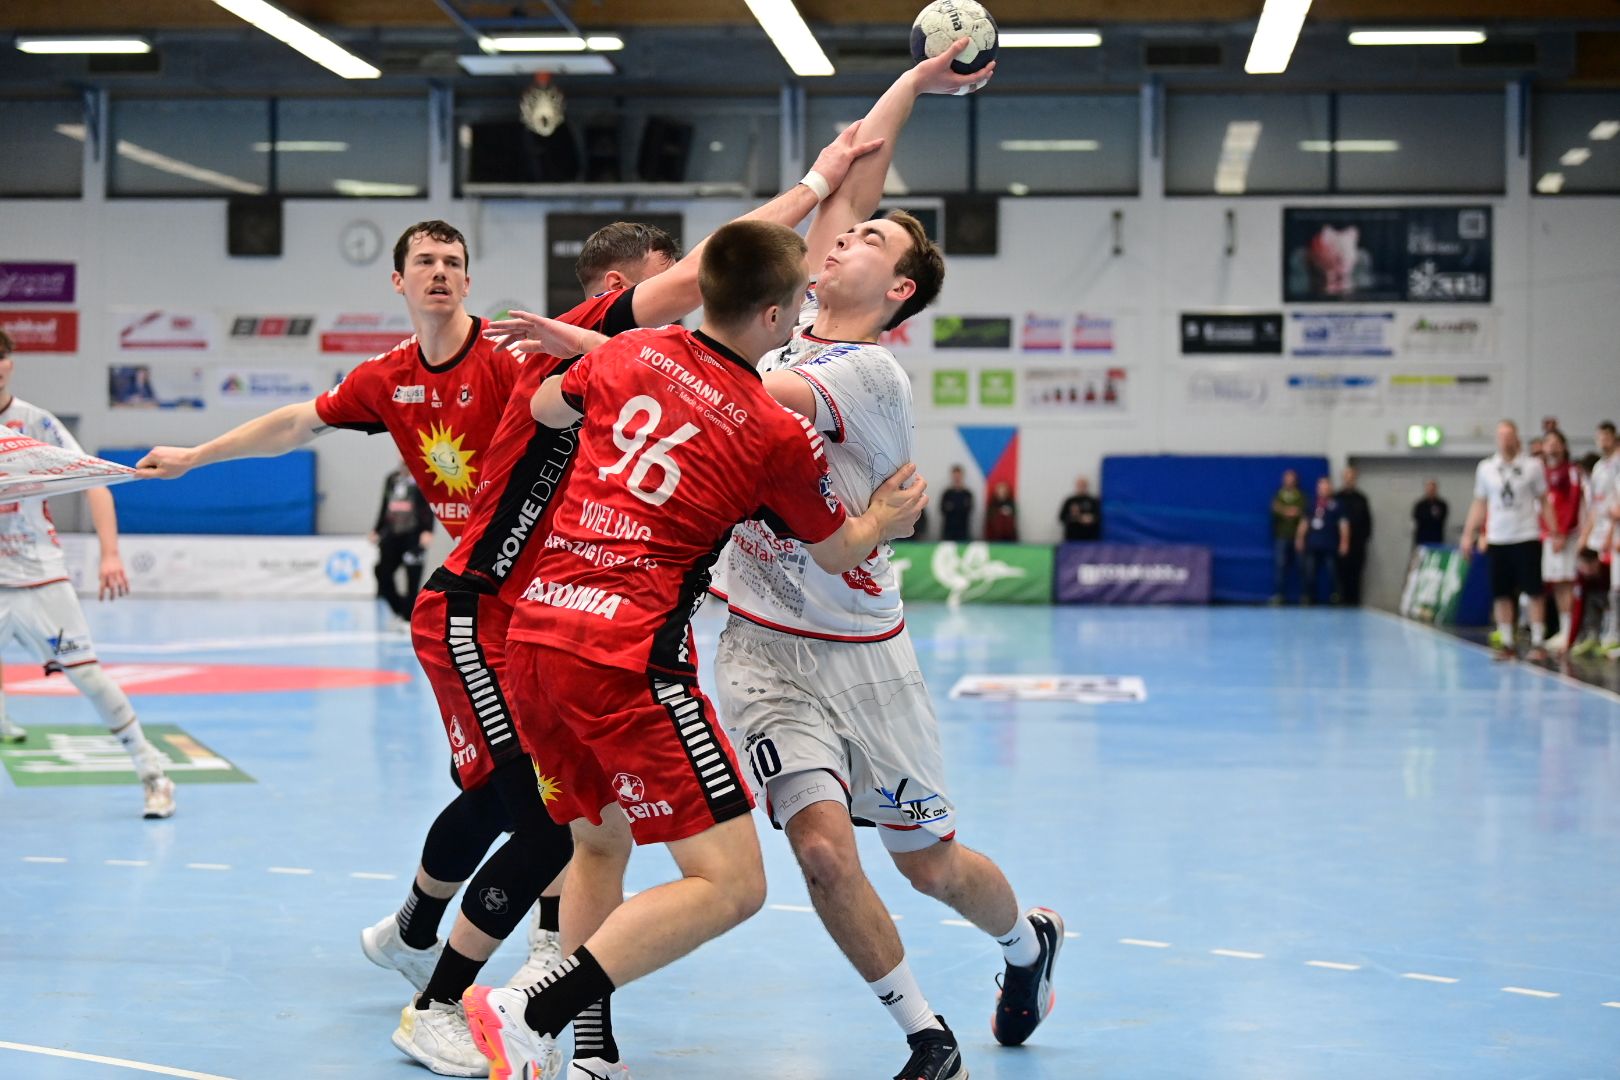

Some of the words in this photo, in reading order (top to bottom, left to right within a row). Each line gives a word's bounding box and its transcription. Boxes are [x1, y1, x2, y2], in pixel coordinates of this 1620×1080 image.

[639, 345, 724, 406] WORTMANN
[721, 402, 748, 425] AG
[666, 383, 676, 393] IT
[679, 391, 697, 408] Made
[696, 404, 704, 413] in
[703, 409, 735, 436] Germany
[597, 394, 702, 507] 96
[429, 502, 471, 518] MER
[731, 534, 777, 565] tzlar
[452, 743, 477, 769] erra
[749, 738, 782, 788] 10
[620, 799, 674, 824] terra
